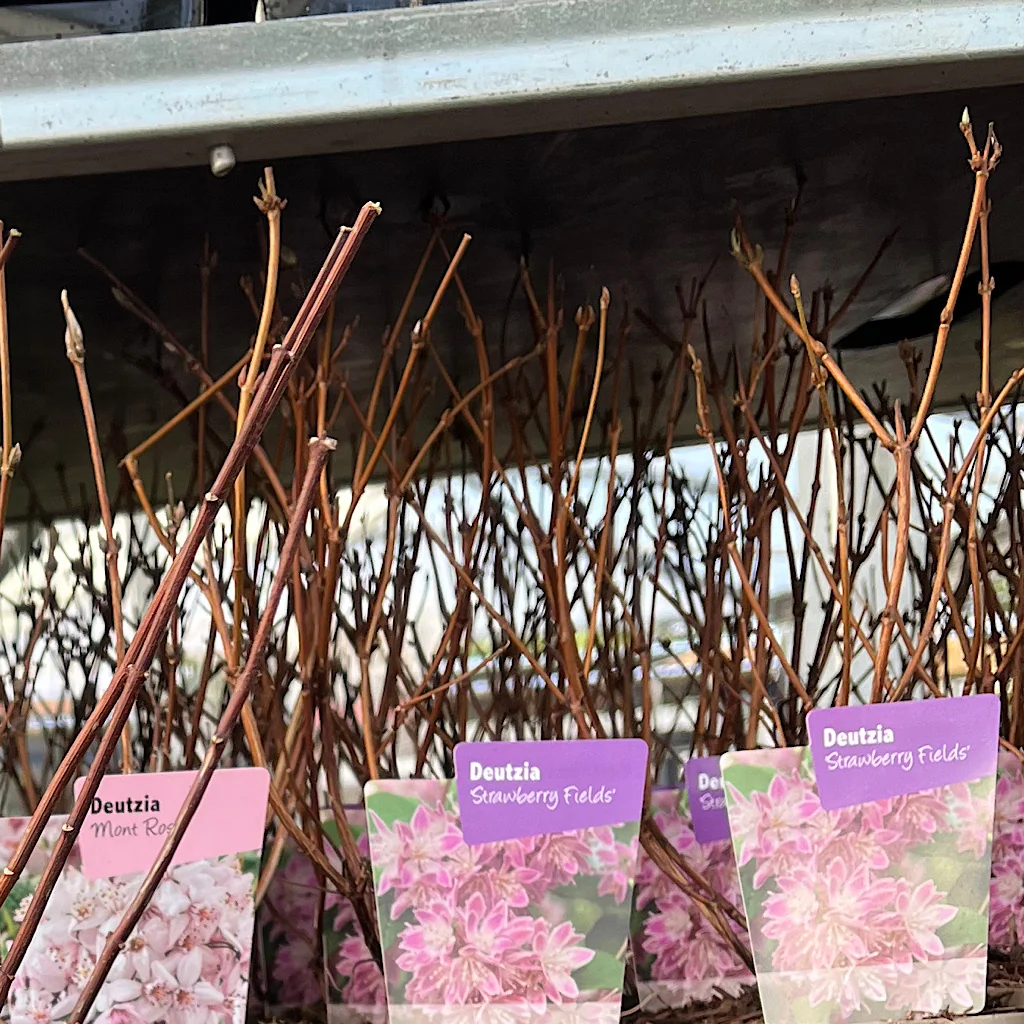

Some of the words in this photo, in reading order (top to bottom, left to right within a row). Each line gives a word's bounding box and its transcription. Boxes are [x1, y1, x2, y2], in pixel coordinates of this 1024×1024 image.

[823, 724, 894, 747] Deutzia
[470, 761, 541, 781] Deutzia
[91, 794, 160, 814] Deutzia
